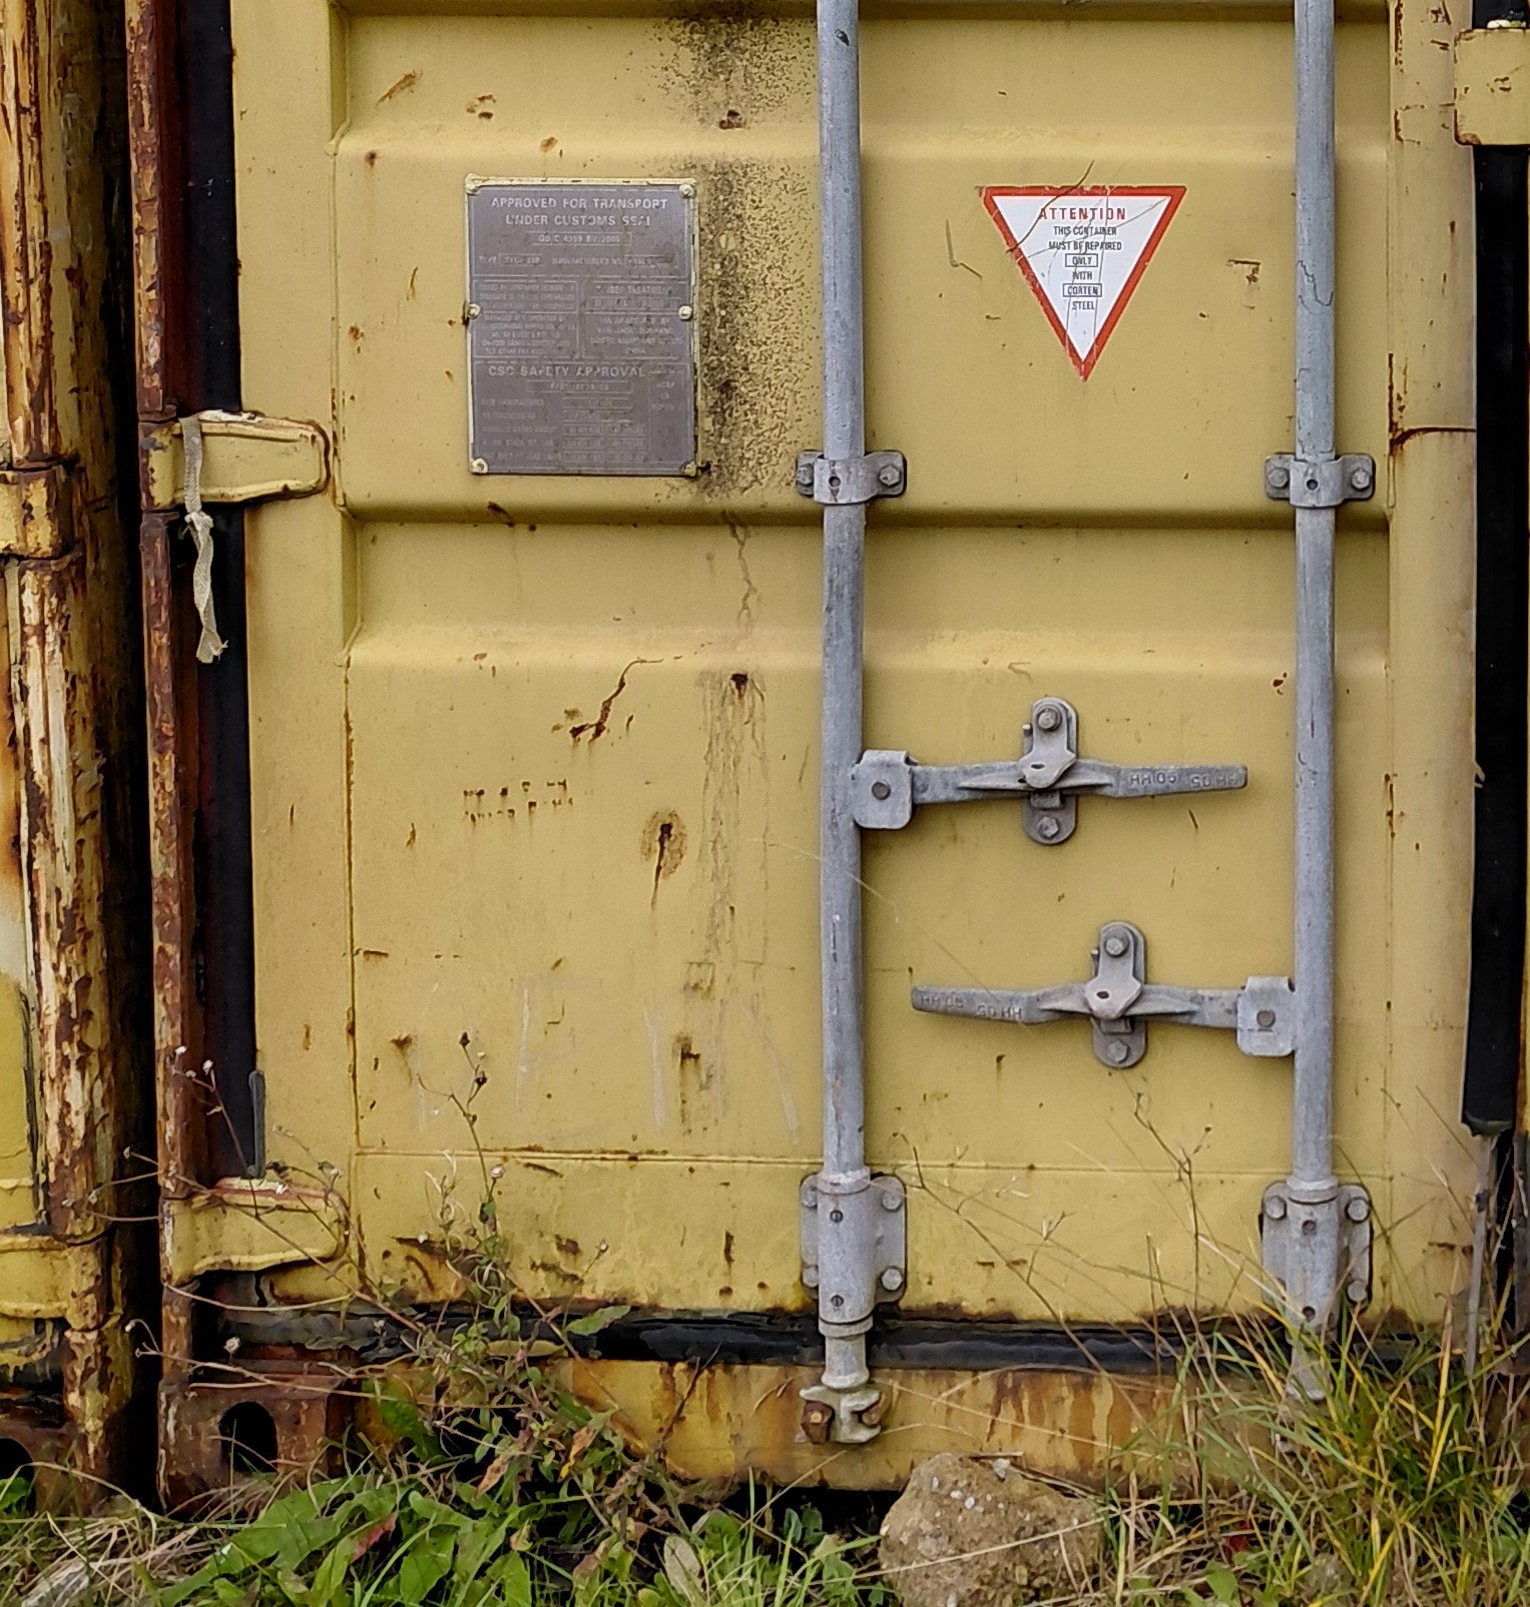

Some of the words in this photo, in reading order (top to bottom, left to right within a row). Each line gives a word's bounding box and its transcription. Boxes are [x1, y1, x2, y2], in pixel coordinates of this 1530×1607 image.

[491, 197, 557, 209] APPROVED
[562, 197, 587, 210] FOR
[592, 197, 668, 210] TRANSPORT
[1040, 208, 1126, 220] ATTENTION
[1053, 226, 1072, 236] THIS
[1073, 226, 1117, 236] CONTAINER
[1048, 241, 1071, 250] MUST
[1085, 241, 1122, 251] REPAIRED
[1072, 256, 1092, 265] ONLY
[1072, 271, 1093, 280] WITH
[1072, 301, 1095, 310] STEEL
